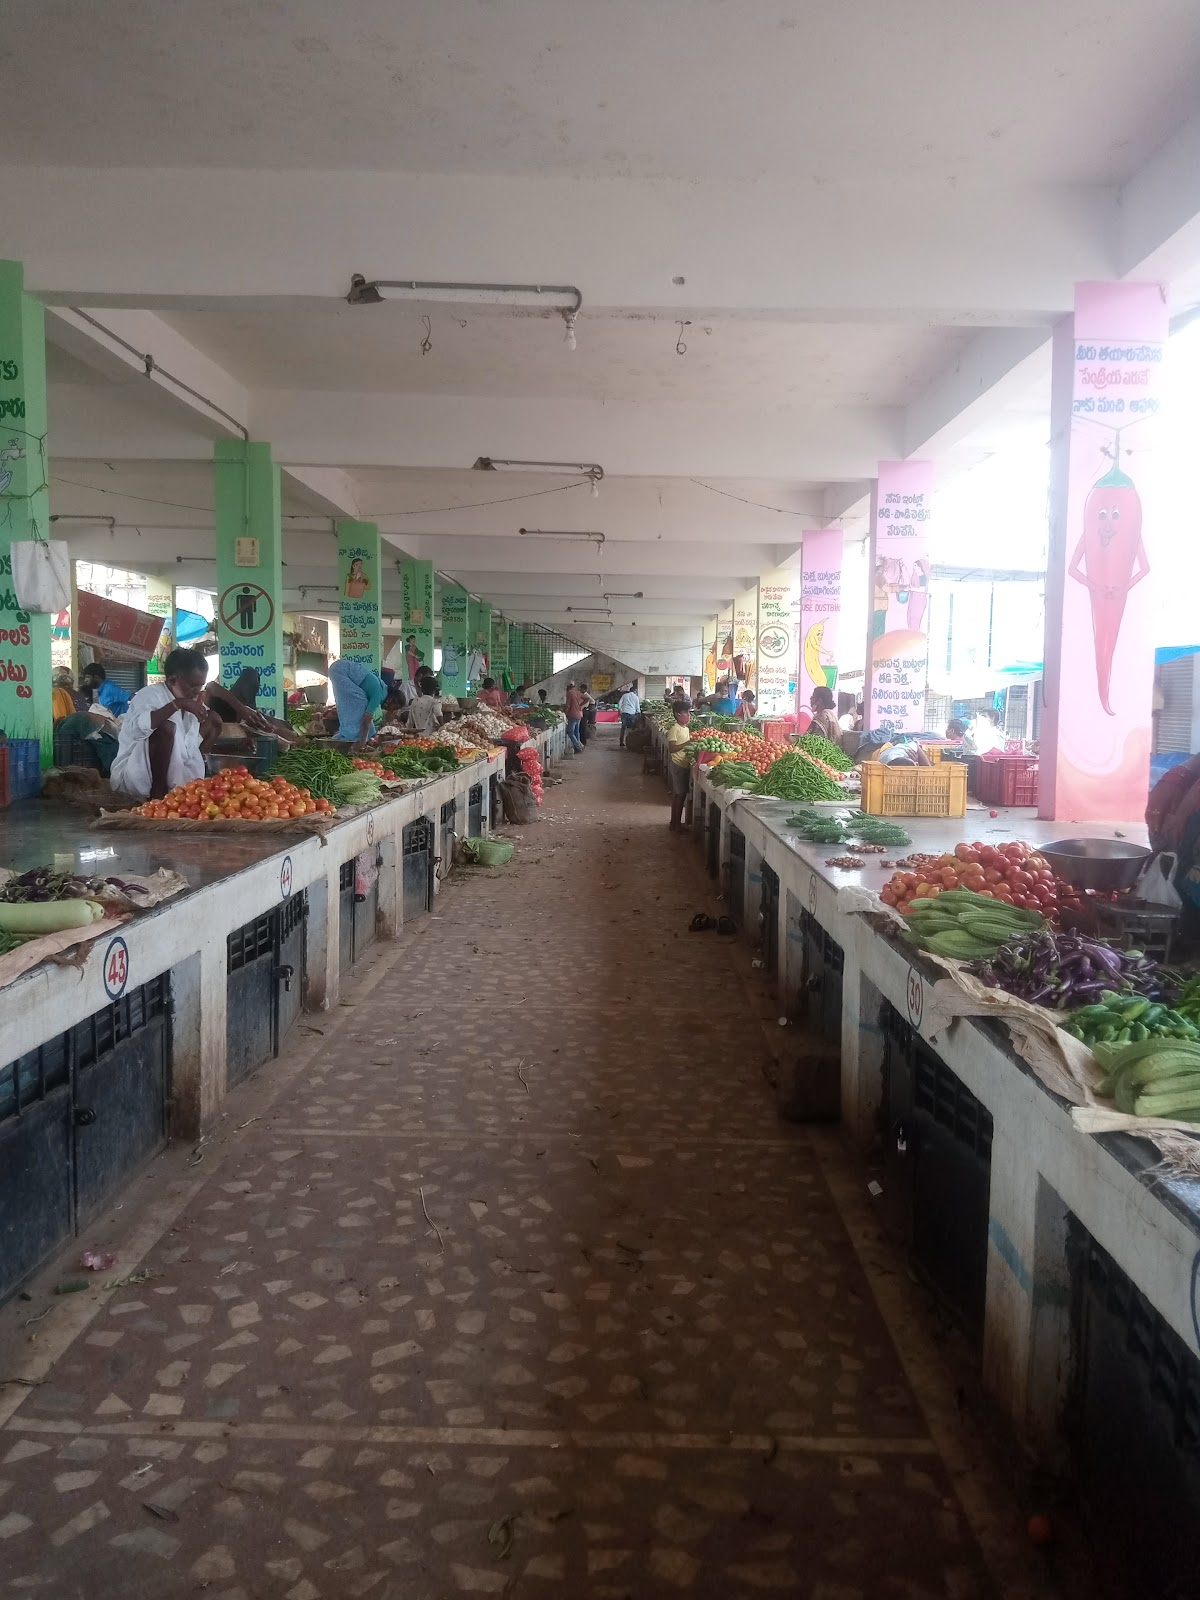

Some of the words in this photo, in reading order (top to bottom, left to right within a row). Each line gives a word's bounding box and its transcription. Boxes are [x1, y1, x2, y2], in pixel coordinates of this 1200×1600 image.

[220, 641, 264, 657] బహిరంగ
[108, 949, 126, 986] 43
[909, 976, 921, 1016] 30
